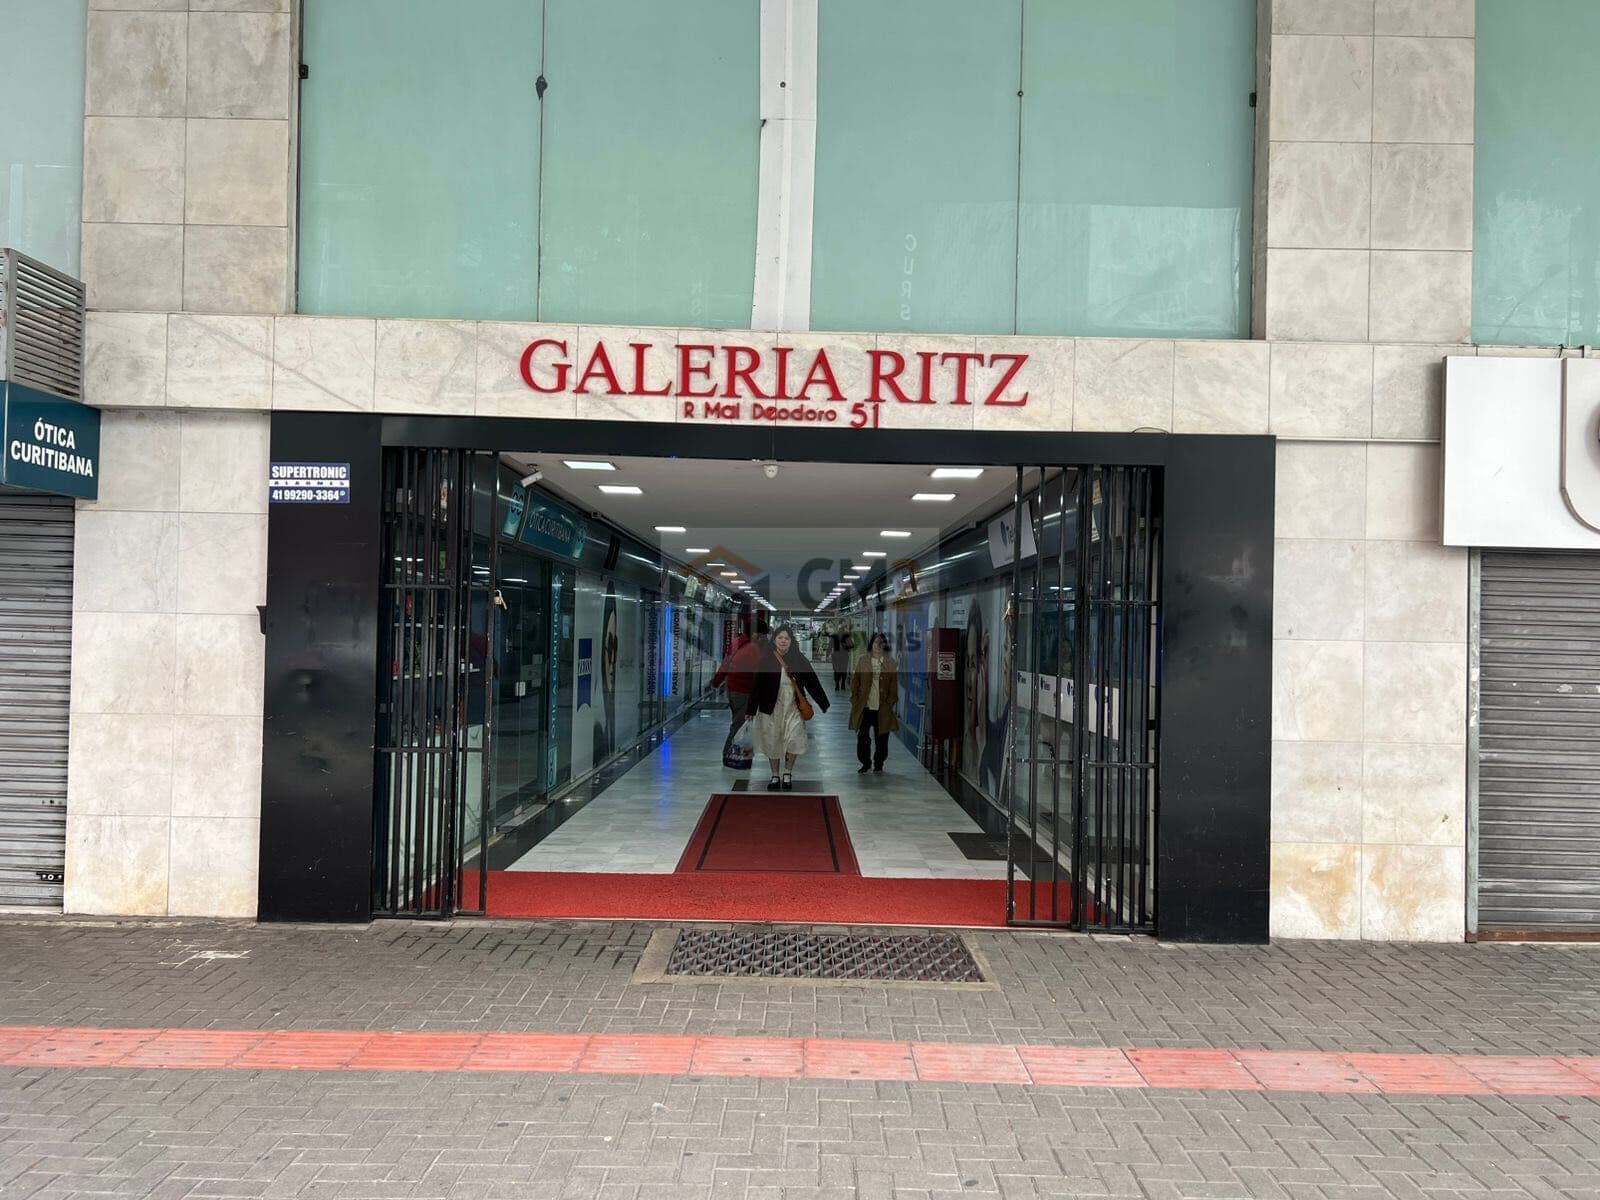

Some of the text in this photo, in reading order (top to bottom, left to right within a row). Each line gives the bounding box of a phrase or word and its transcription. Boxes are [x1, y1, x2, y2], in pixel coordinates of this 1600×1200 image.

[519, 338, 1030, 407] GALERIA RITZ
[684, 402, 880, 429] R Mal Deodoro 51
[34, 416, 76, 450] ÓTICA
[10, 439, 94, 478] CURITIBANA
[271, 465, 347, 479] SUPERTRONIC
[272, 489, 340, 501] 41 99290-3364
[671, 611, 680, 696] APARELHOS AUDITIVOS
